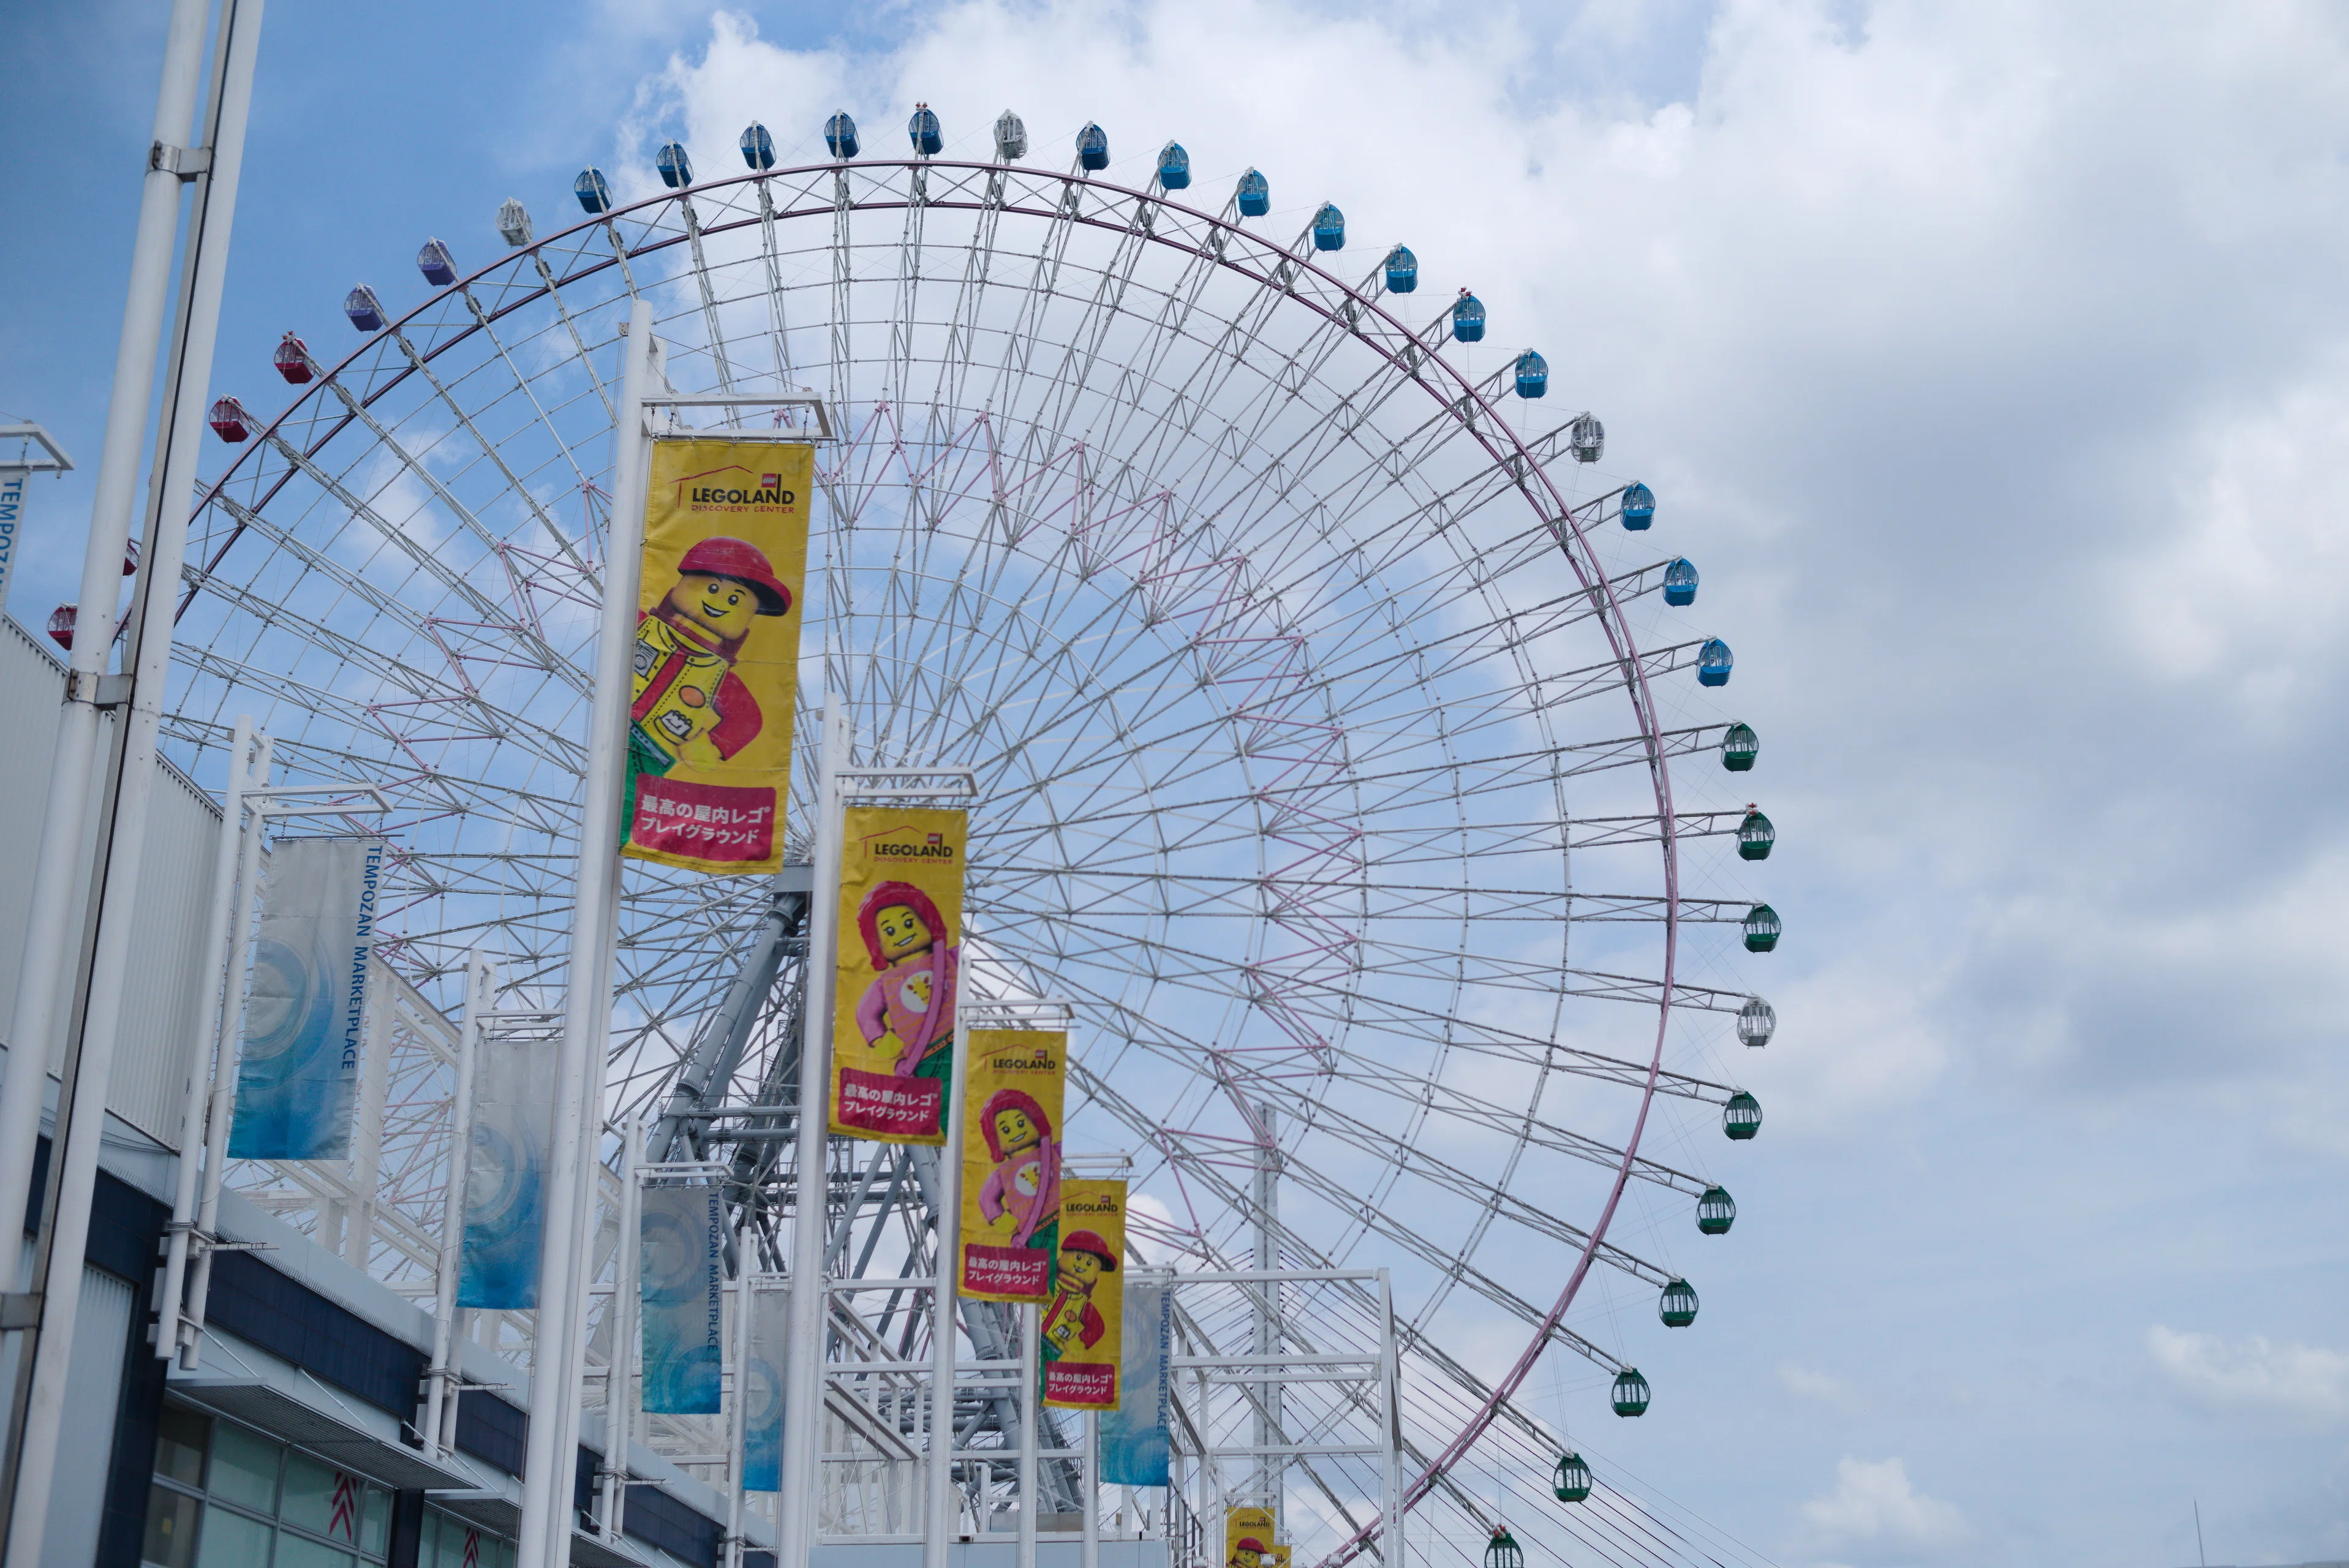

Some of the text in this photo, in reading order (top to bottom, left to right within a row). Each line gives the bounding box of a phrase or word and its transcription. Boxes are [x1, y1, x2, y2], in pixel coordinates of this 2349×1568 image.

[693, 474, 795, 504] LEGOLAND
[0, 478, 23, 592] TEMPO
[641, 817, 760, 844] プレイグラウンド
[875, 833, 953, 857] LEGOLAND
[342, 845, 383, 1069] TEMPOZAN MARKETPLACE
[994, 1049, 1056, 1069] LEGOLAND
[844, 1101, 930, 1121] プレイグラウンド
[1066, 1195, 1118, 1212] LEGOLAND
[708, 1192, 719, 1351] TEMPOZAN MARKETPLACE
[968, 1270, 1039, 1285] プレイグラウンド
[1158, 1292, 1171, 1431] TEMPOZAN MARKETPLACE
[1240, 1517, 1270, 1526] LEGOLAND
